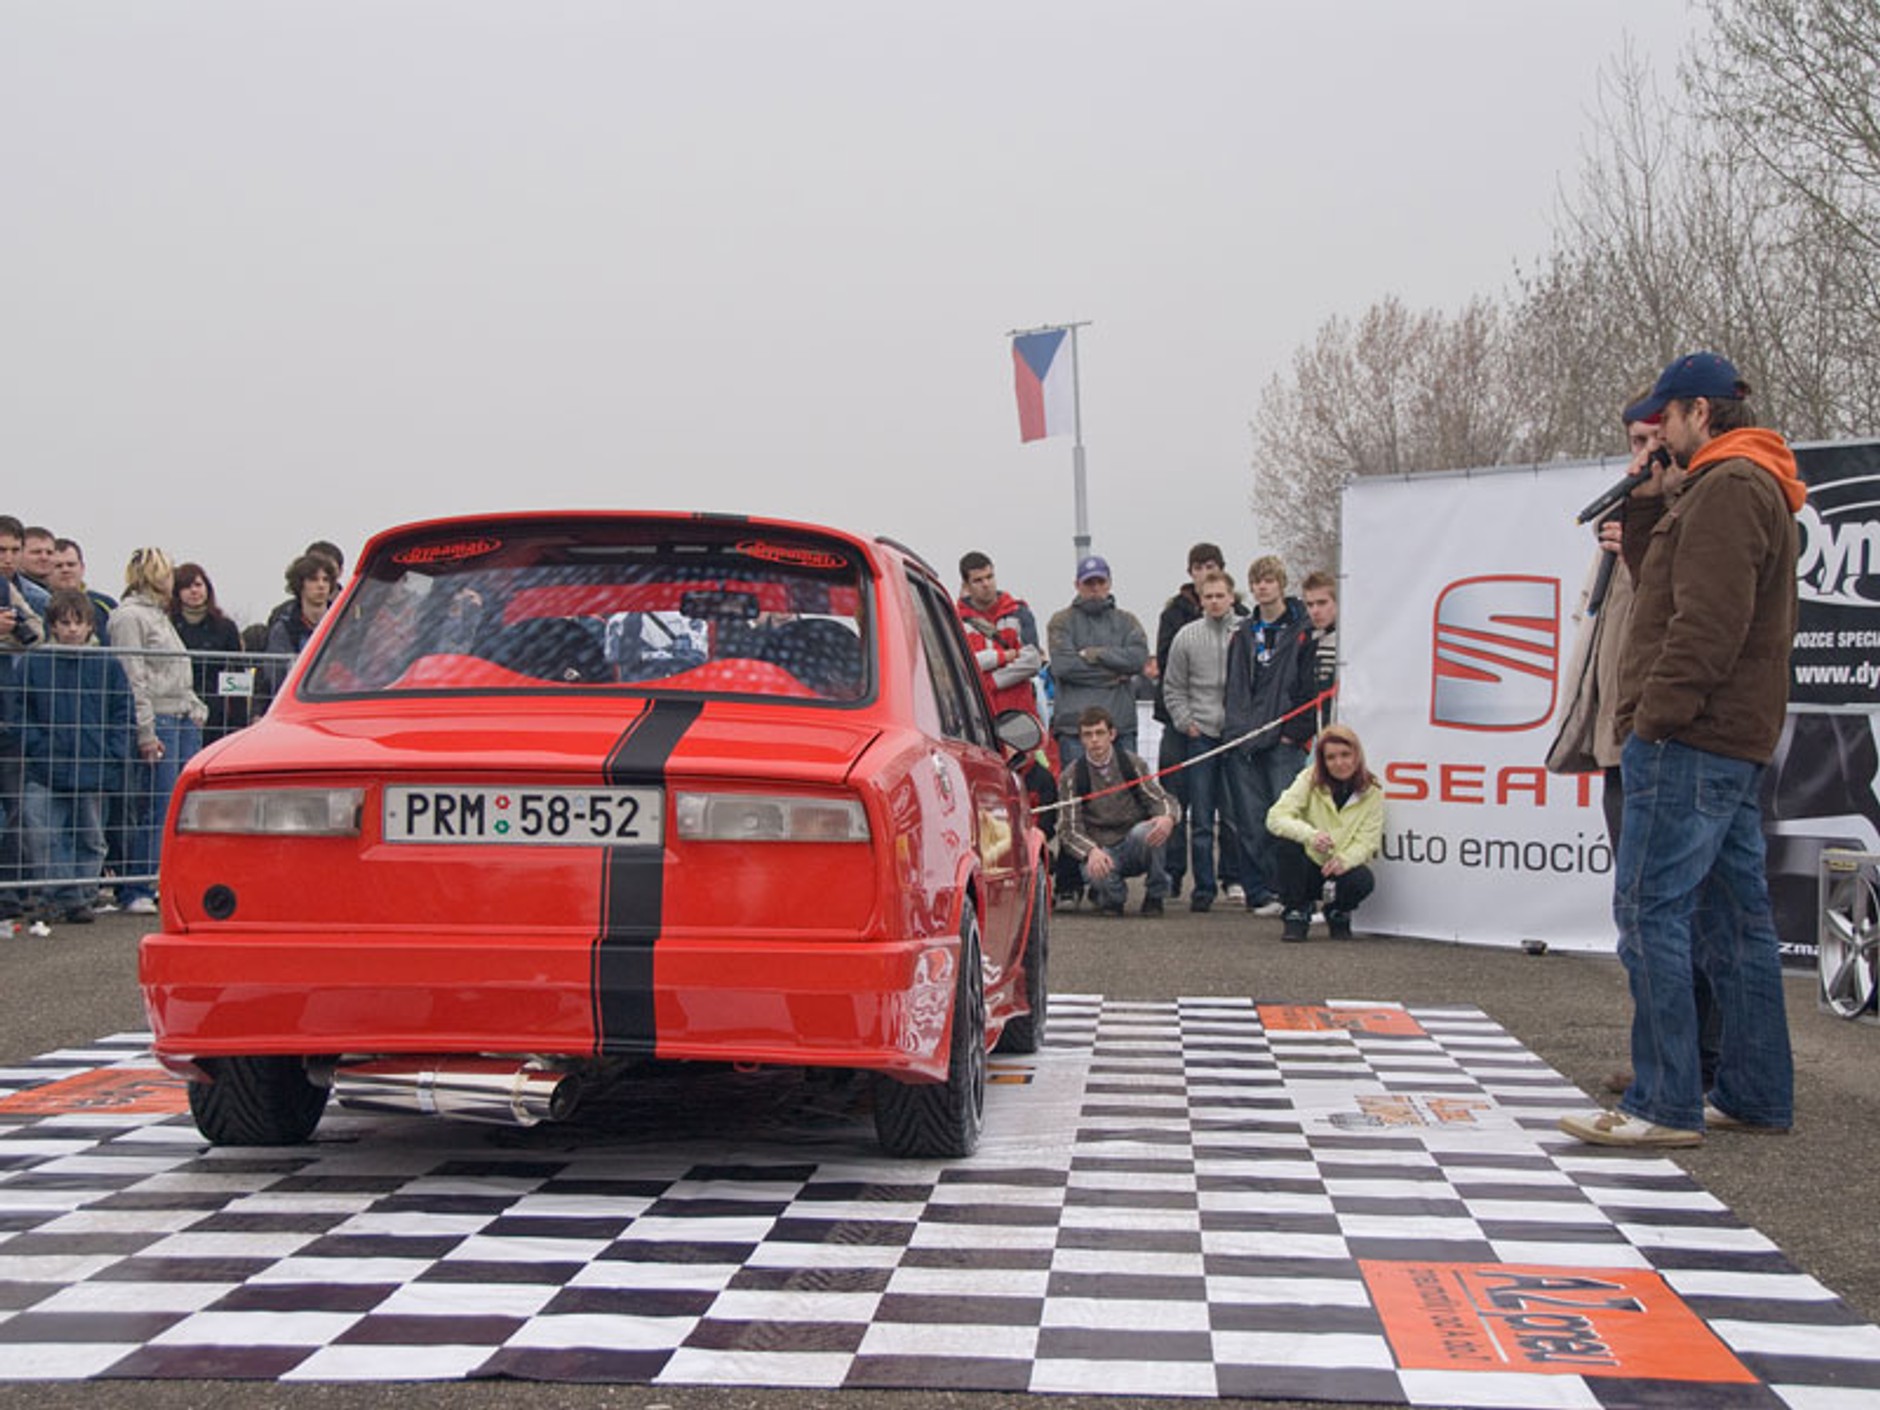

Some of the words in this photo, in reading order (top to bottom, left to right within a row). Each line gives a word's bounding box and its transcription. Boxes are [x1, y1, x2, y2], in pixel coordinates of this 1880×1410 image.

[1384, 762, 1604, 807] SEAT
[406, 793, 485, 835] PRM
[520, 795, 639, 837] 58-52
[1373, 829, 1447, 864] uto
